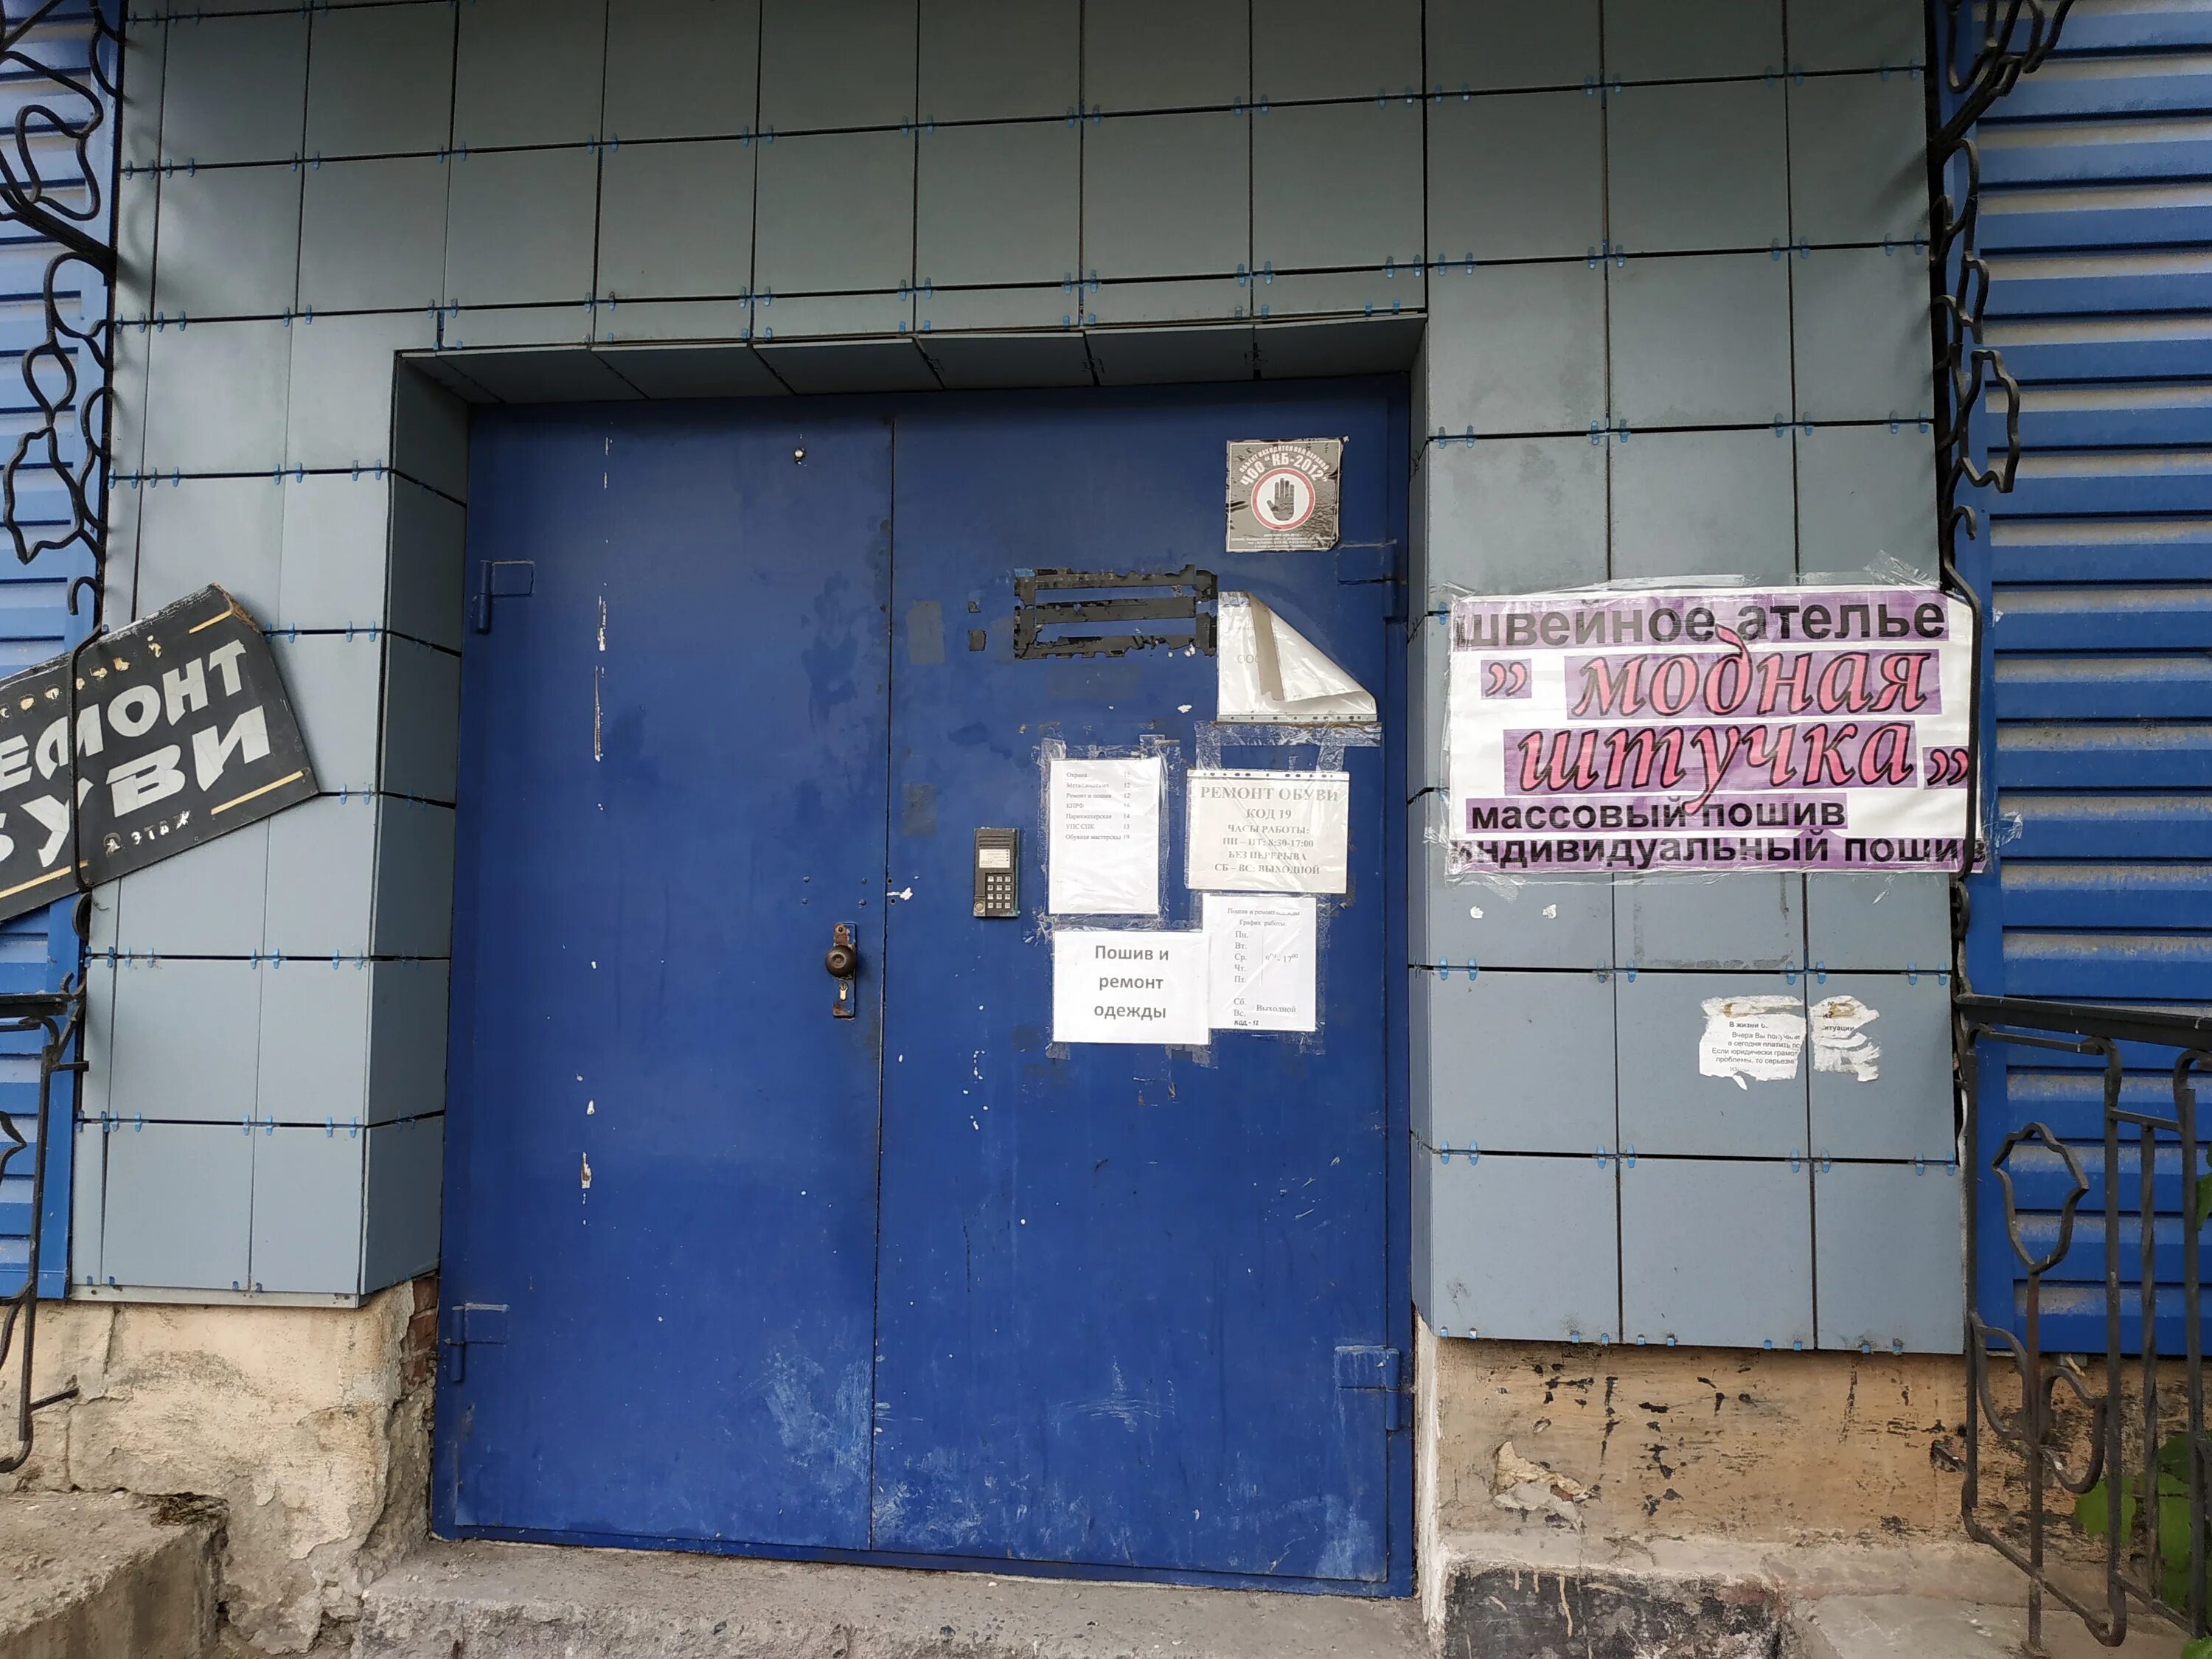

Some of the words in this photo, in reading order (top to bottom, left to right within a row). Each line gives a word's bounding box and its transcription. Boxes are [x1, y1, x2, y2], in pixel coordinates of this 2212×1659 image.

[1736, 601, 1946, 641] ателье
[1571, 622, 1930, 717] модная
[1200, 786, 1274, 801] РЕМОНТ
[1279, 787, 1339, 801] ОБУВИ
[1245, 808, 1276, 820] КОД
[1279, 809, 1292, 819] 19
[1703, 801, 1846, 829] пошив
[1228, 824, 1259, 833] ЧАСЫ
[1239, 919, 1262, 927] График
[1235, 931, 1248, 939] Пн.
[1234, 942, 1247, 950] Вт.
[1095, 945, 1153, 960] Пошив
[1159, 949, 1169, 961] и
[1234, 953, 1248, 961] Ср.
[1234, 964, 1247, 972] Чт.
[1099, 976, 1164, 991] ремонт
[1093, 1004, 1166, 1021] одежды
[1234, 1009, 1245, 1018] Вс.
[1256, 1004, 1297, 1013] Выходной
